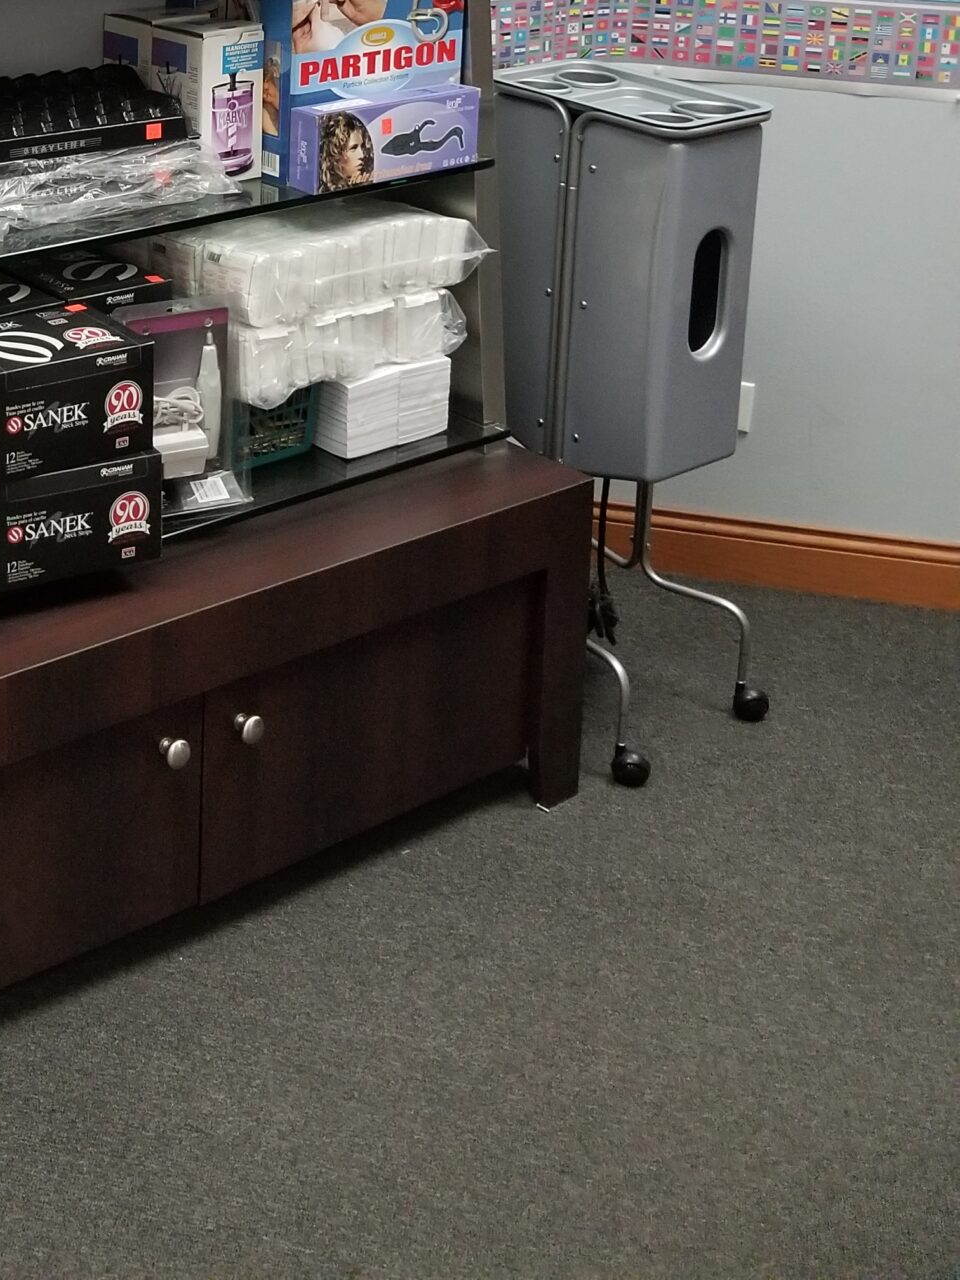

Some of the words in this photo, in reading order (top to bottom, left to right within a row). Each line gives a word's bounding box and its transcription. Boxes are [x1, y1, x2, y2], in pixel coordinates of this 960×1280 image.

[300, 39, 457, 86] PARTIGON
[111, 387, 138, 413] 90
[24, 402, 87, 431] SANEK
[110, 412, 137, 425] years
[6, 452, 16, 464] 12
[116, 497, 144, 523] 90
[25, 513, 89, 541] SANEK
[115, 523, 143, 535] years
[7, 561, 17, 573] 12
